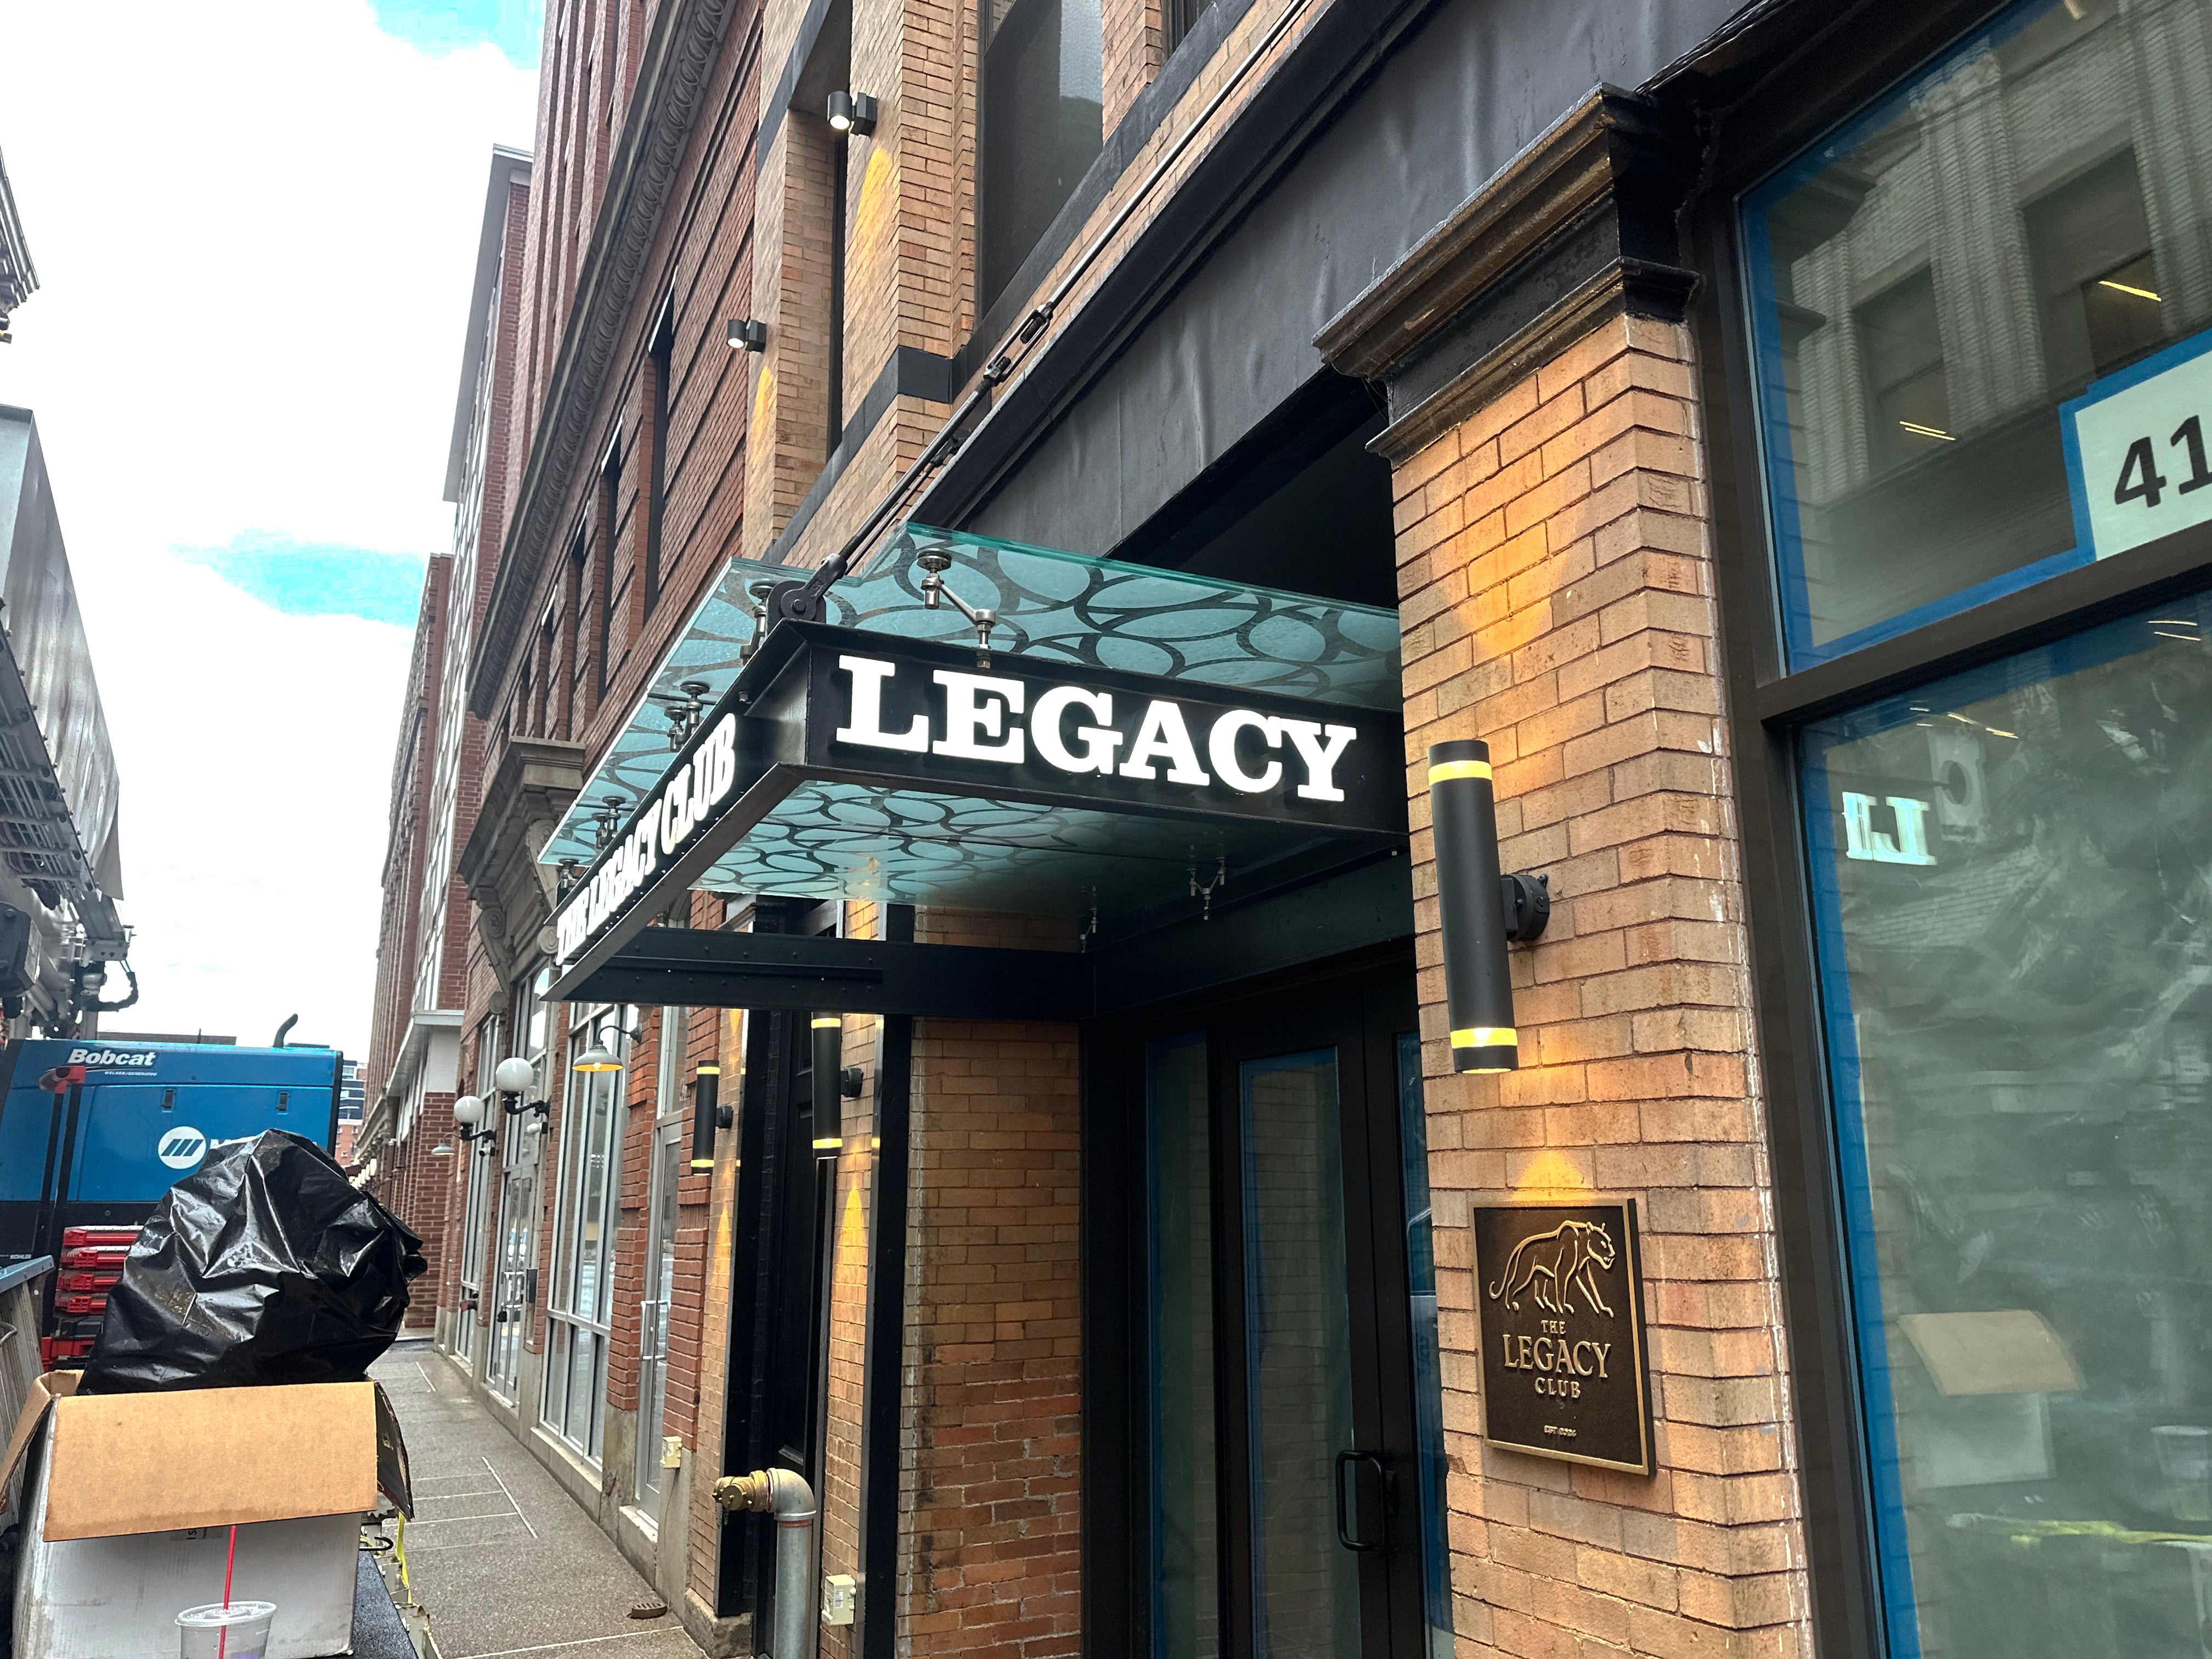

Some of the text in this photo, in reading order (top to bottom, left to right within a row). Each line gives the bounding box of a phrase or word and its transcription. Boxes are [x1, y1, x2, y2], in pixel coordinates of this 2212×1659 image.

[2114, 415, 2212, 508] 41
[836, 655, 1357, 802] LEGACY
[586, 799, 662, 935] LEGACY
[661, 713, 736, 854] CLUB
[67, 1048, 157, 1066] Bobcat
[1541, 1319, 1566, 1334] THE
[1502, 1334, 1611, 1378] LEGACY
[1534, 1376, 1581, 1399] CLUB
